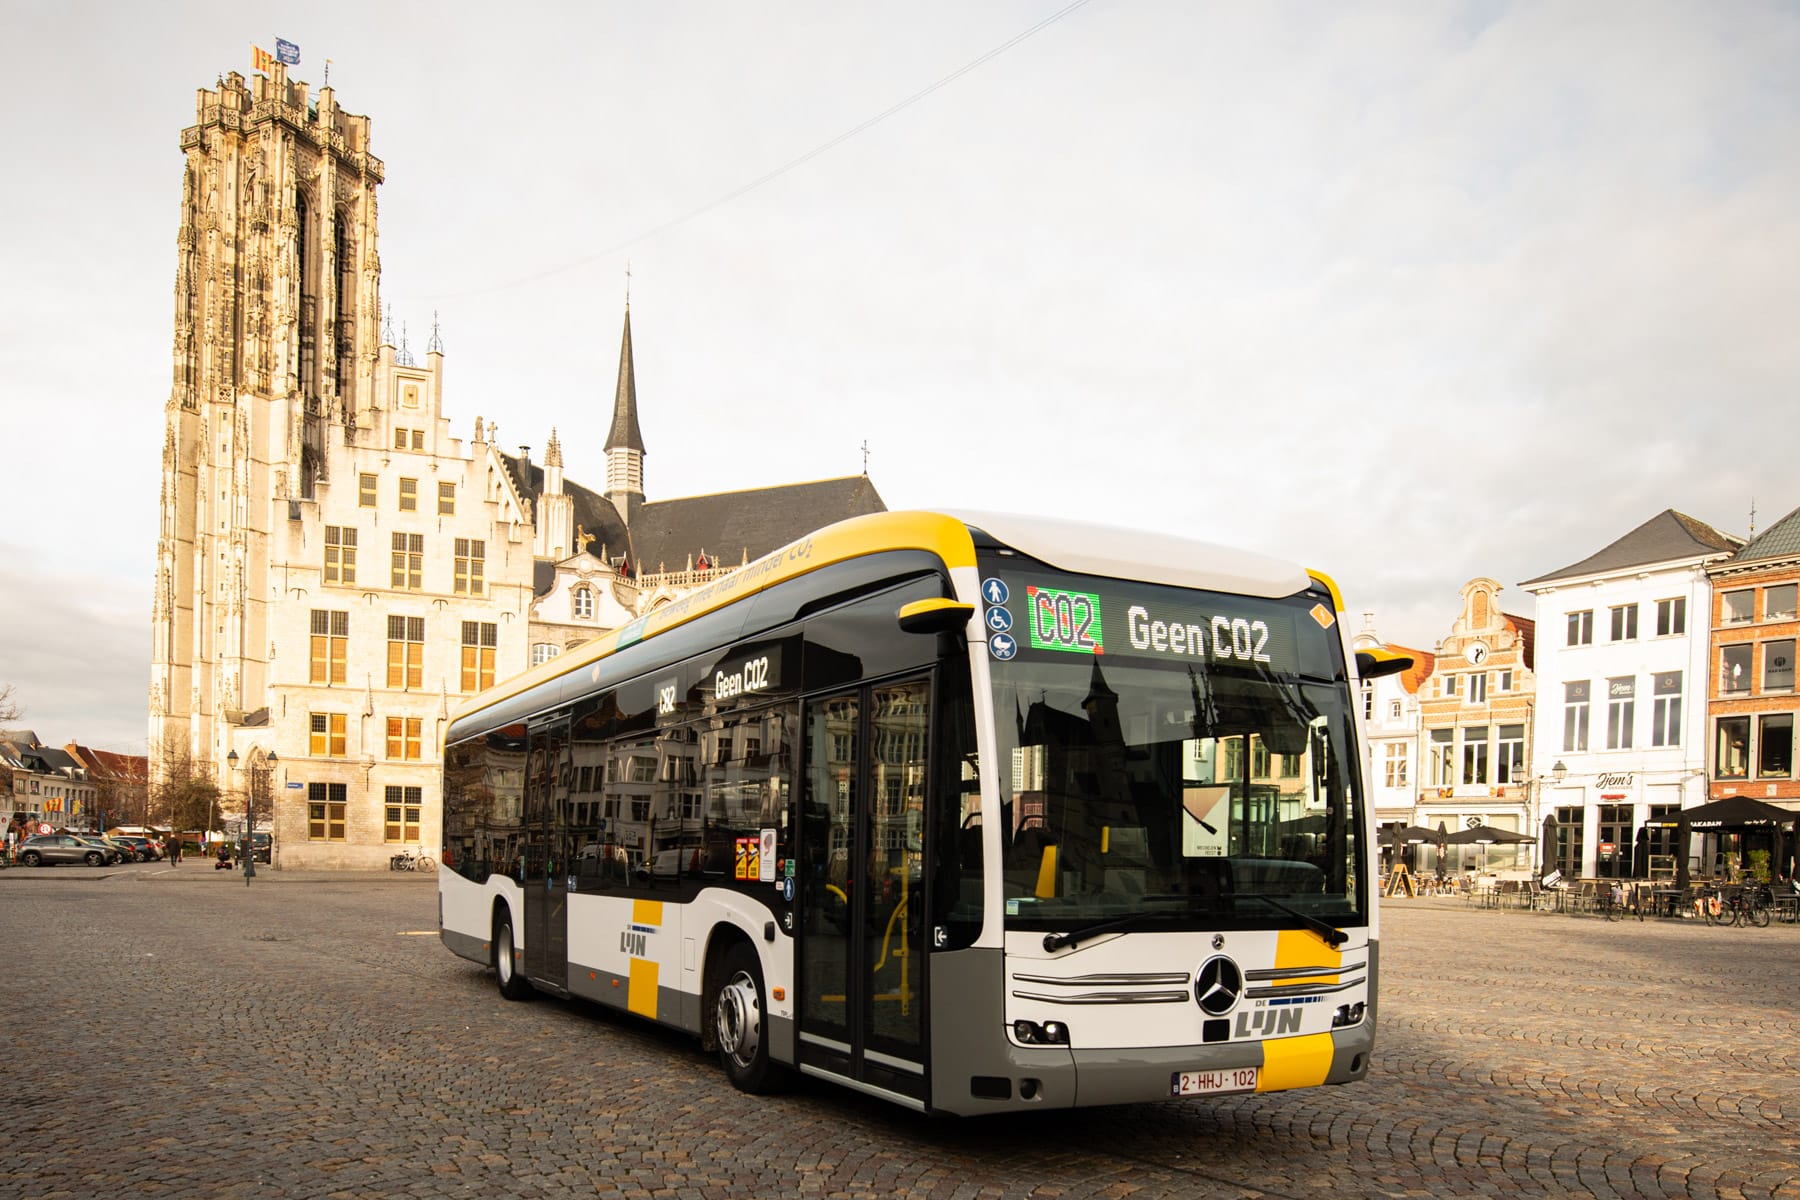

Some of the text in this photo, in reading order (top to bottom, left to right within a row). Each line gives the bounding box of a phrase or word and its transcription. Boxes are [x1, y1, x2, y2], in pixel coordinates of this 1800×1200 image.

[1034, 589, 1096, 649] CO2
[1127, 605, 1270, 663] Geen CO2
[715, 656, 769, 700] Geen CO2
[620, 931, 646, 957] LIJN
[1255, 999, 1266, 1007] DE
[1234, 1007, 1303, 1038] LIJN
